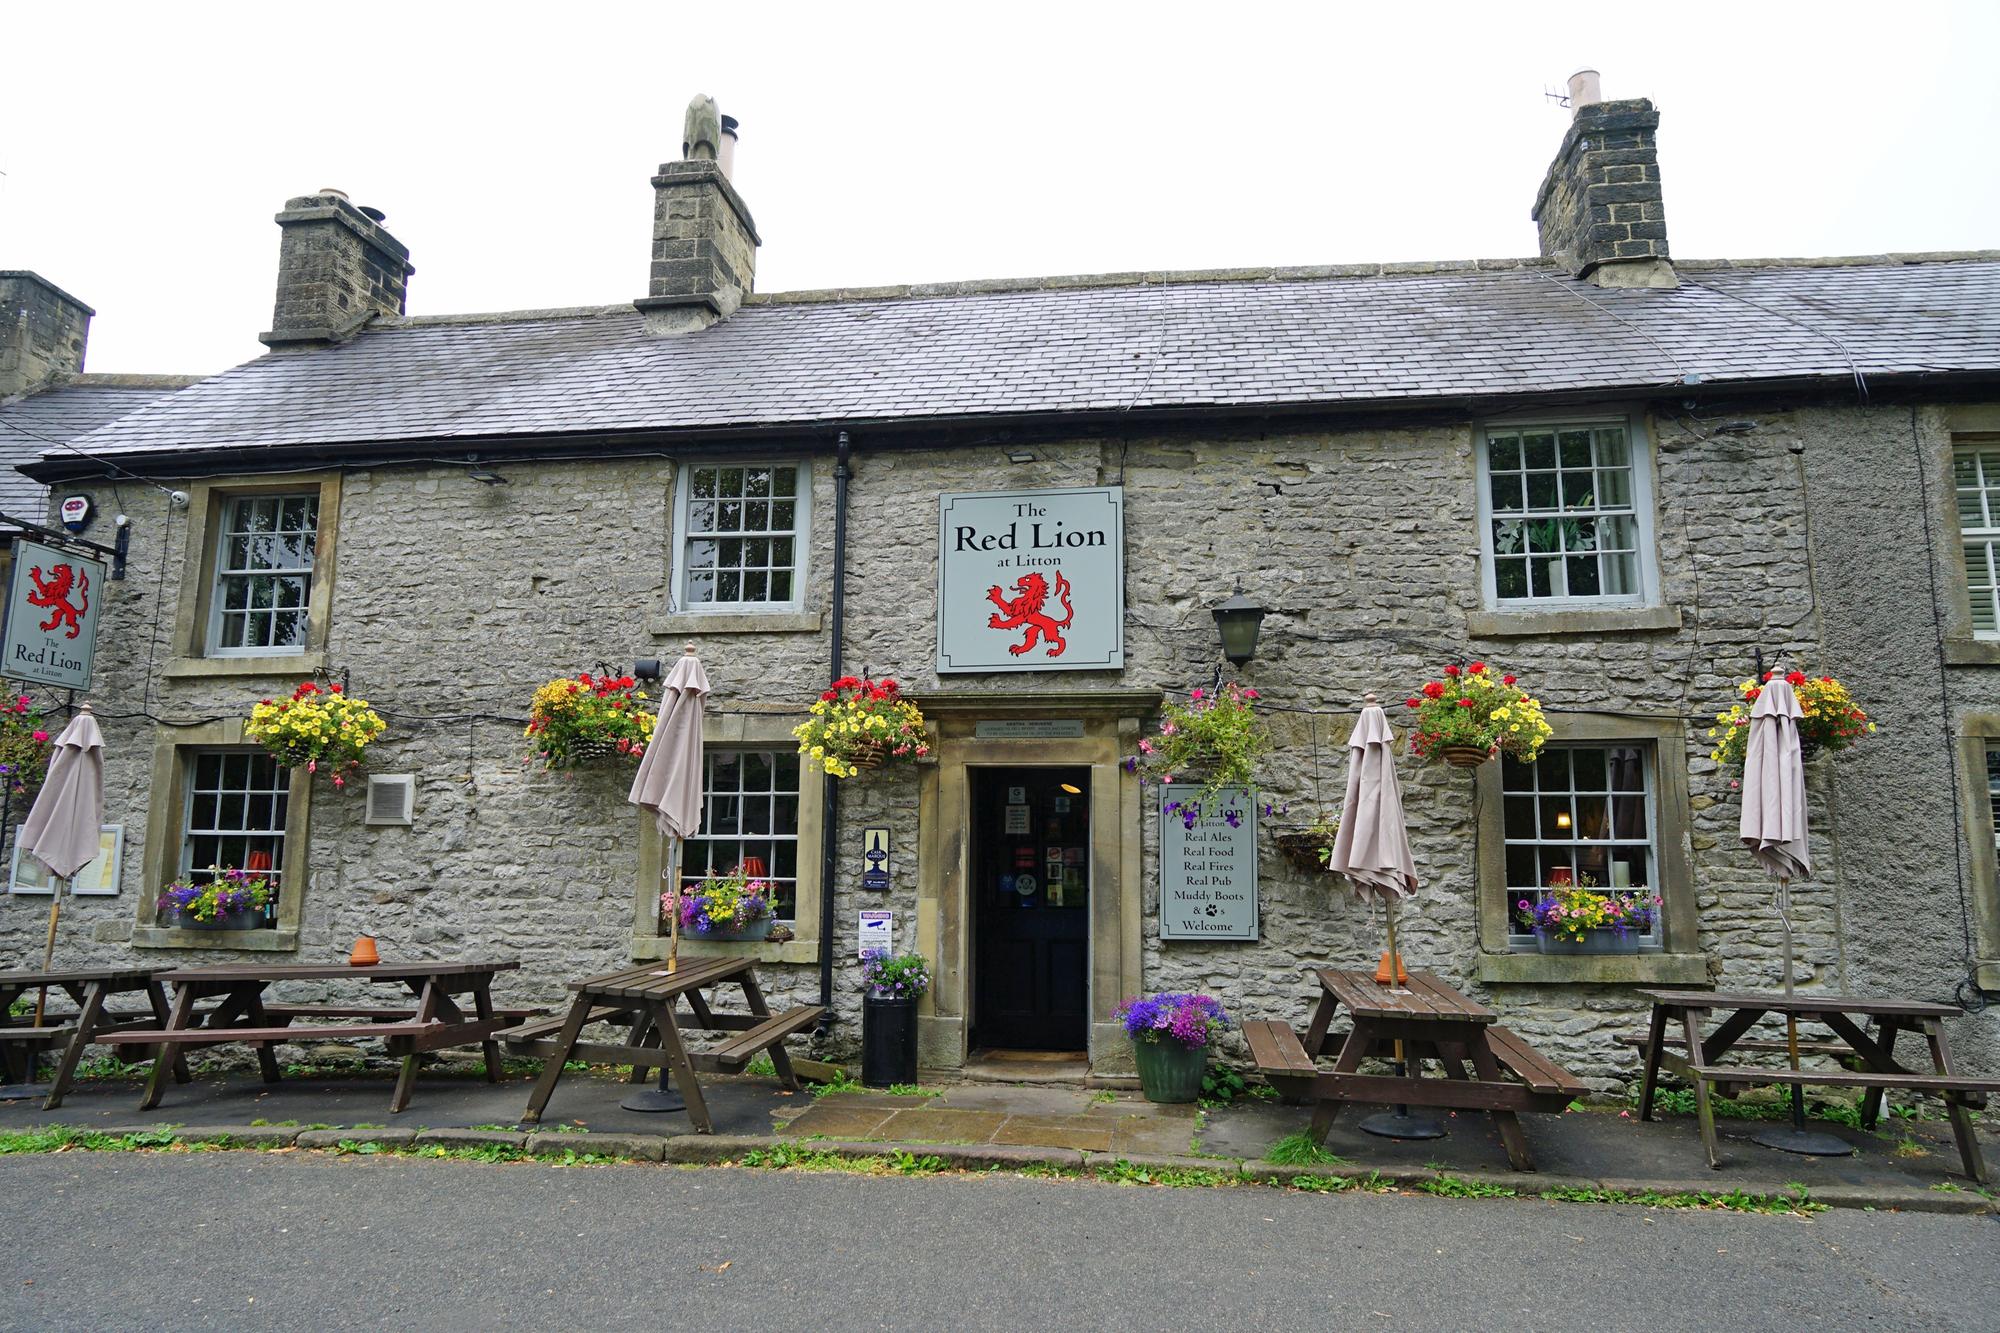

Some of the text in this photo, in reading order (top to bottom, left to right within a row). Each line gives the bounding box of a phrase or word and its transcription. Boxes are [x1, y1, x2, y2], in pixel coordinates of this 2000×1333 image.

[1013, 503, 1047, 517] The
[954, 521, 1107, 551] Red Lion
[997, 554, 1061, 568] at Litton
[45, 637, 59, 648] The
[15, 643, 82, 671] Red Lion
[41, 667, 62, 678] Litton
[1185, 832, 1232, 842] Real Ales
[1183, 846, 1234, 856] Real Food
[1184, 861, 1234, 871] Real Fires
[1186, 876, 1232, 886] Real Pub
[1174, 890, 1244, 904] Muddy Boots
[1193, 906, 1201, 915] &
[1182, 920, 1233, 931] Welcome
